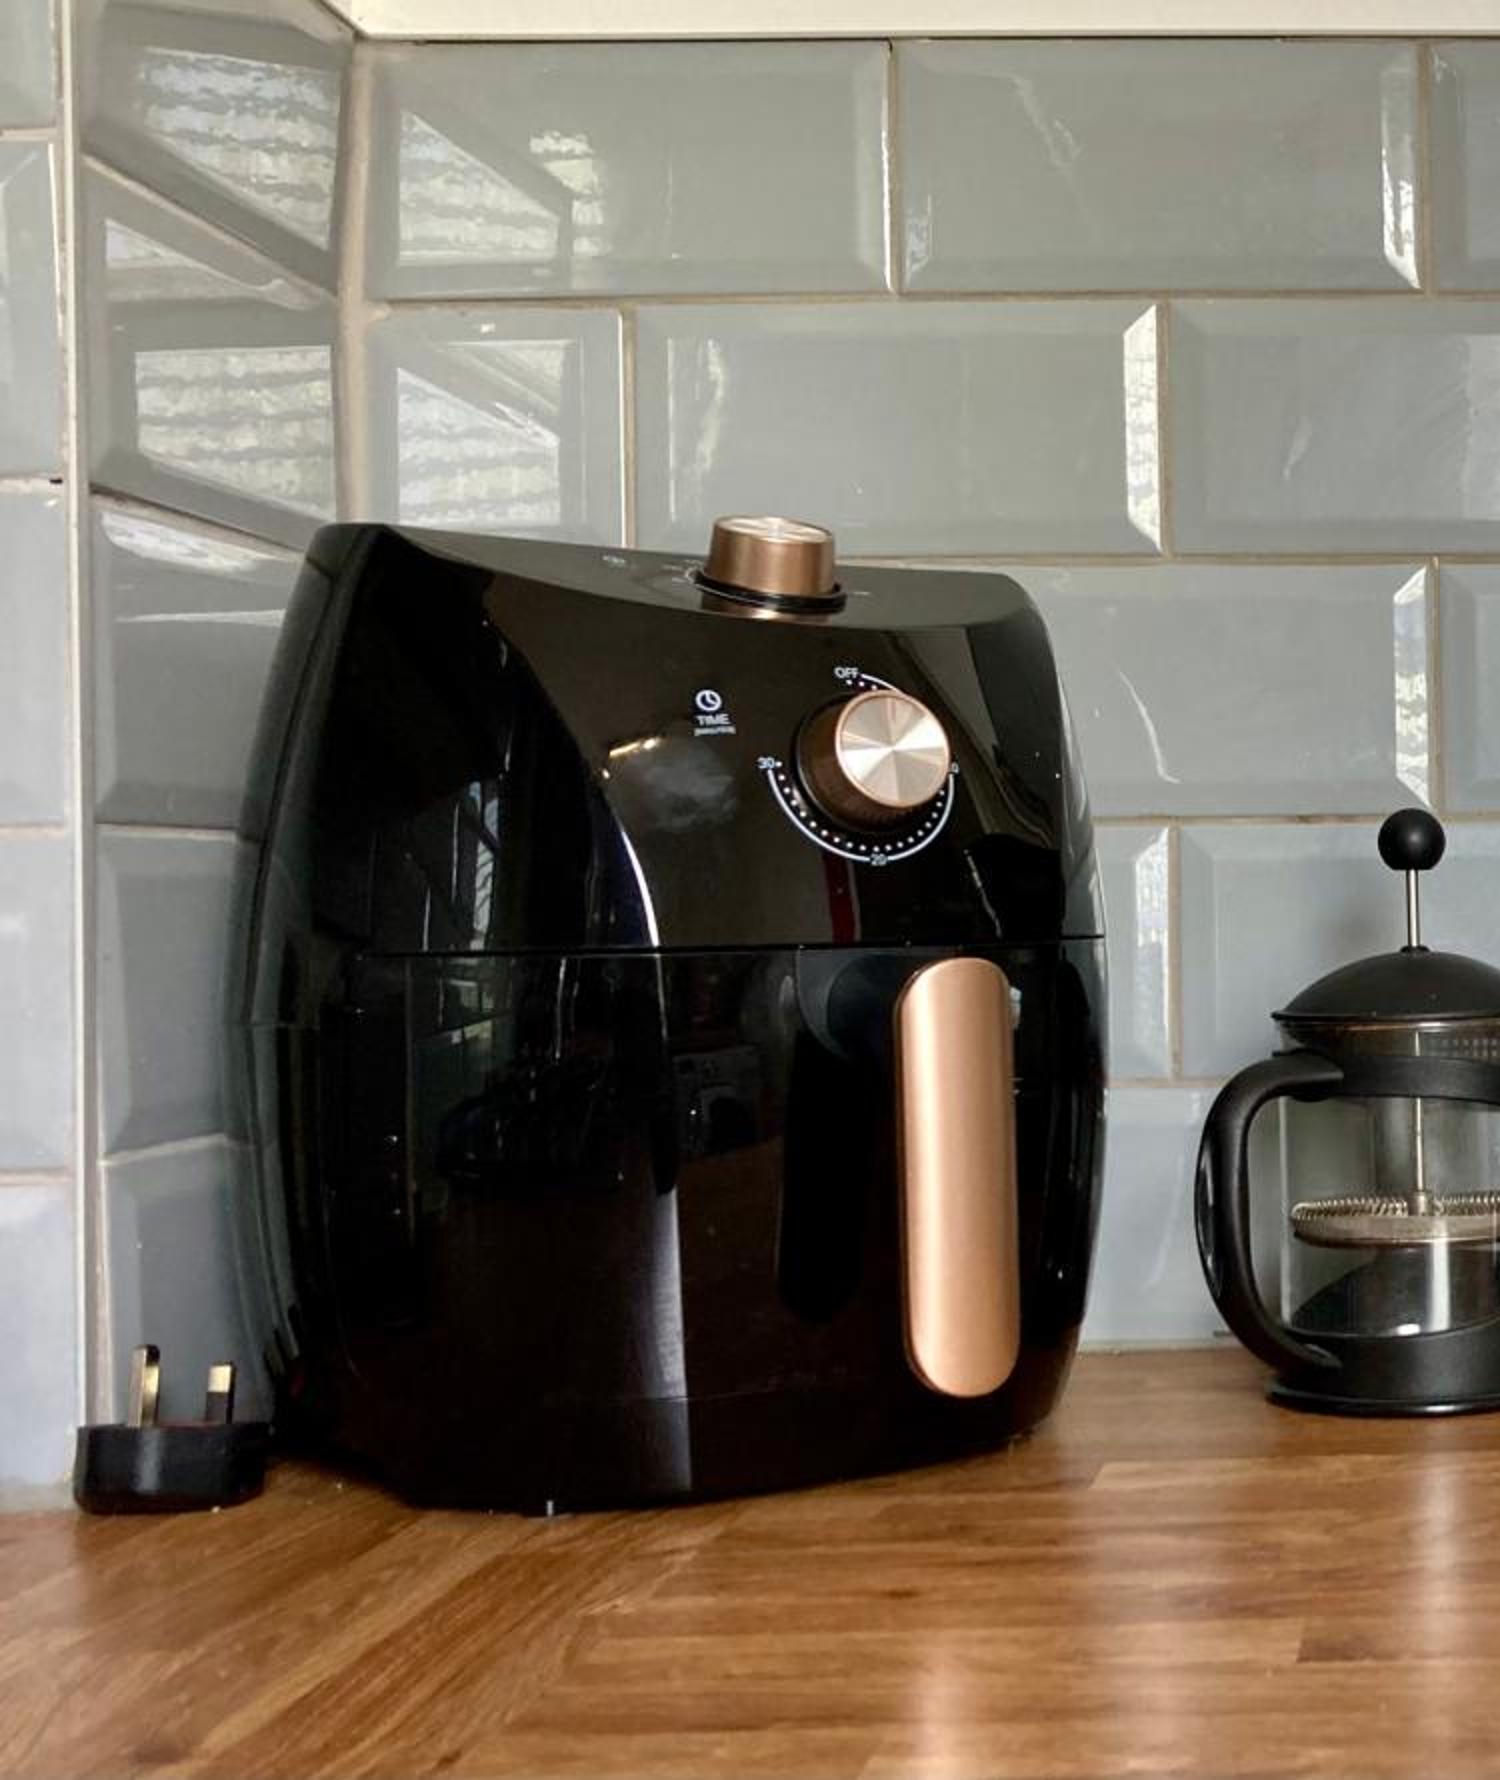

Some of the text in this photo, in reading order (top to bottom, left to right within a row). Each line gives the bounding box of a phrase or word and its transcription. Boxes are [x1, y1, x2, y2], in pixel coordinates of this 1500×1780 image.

[834, 666, 859, 679] OFF
[695, 713, 731, 726] TIME
[758, 756, 775, 769] 30
[870, 853, 887, 866] 20
